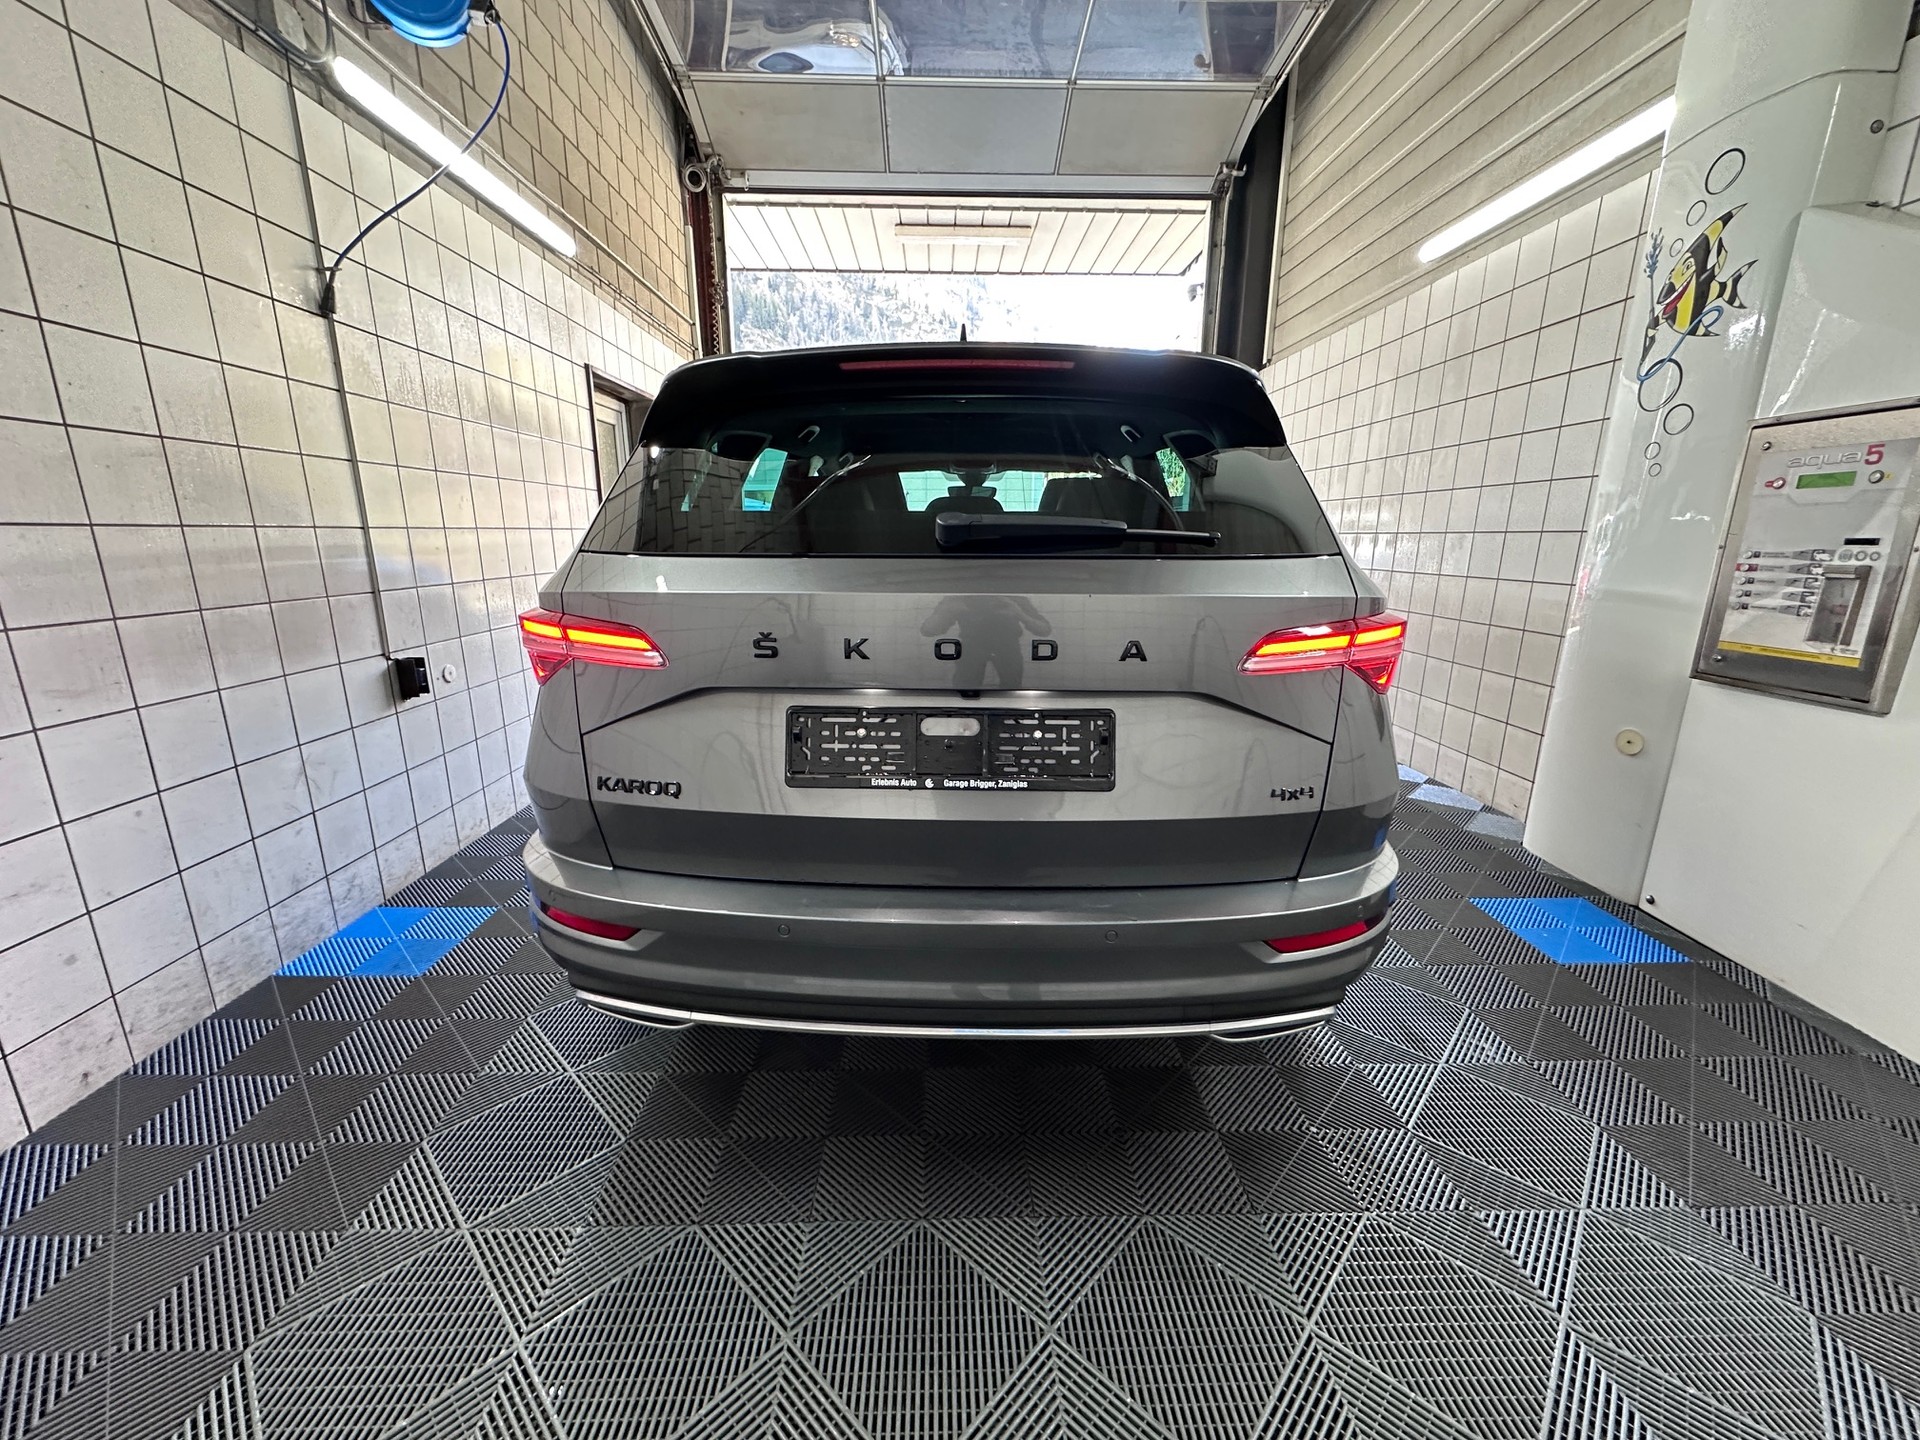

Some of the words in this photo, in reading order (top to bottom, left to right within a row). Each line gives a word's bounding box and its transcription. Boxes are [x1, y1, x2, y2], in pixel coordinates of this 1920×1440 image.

[752, 631, 1147, 662] ŠKODA
[597, 776, 682, 799] KAROQ
[871, 778, 899, 786] Erlebnis
[900, 778, 917, 787] Auto
[943, 779, 969, 788] Garage
[969, 779, 997, 789] Brigger,
[1270, 786, 1314, 801] 4x4
